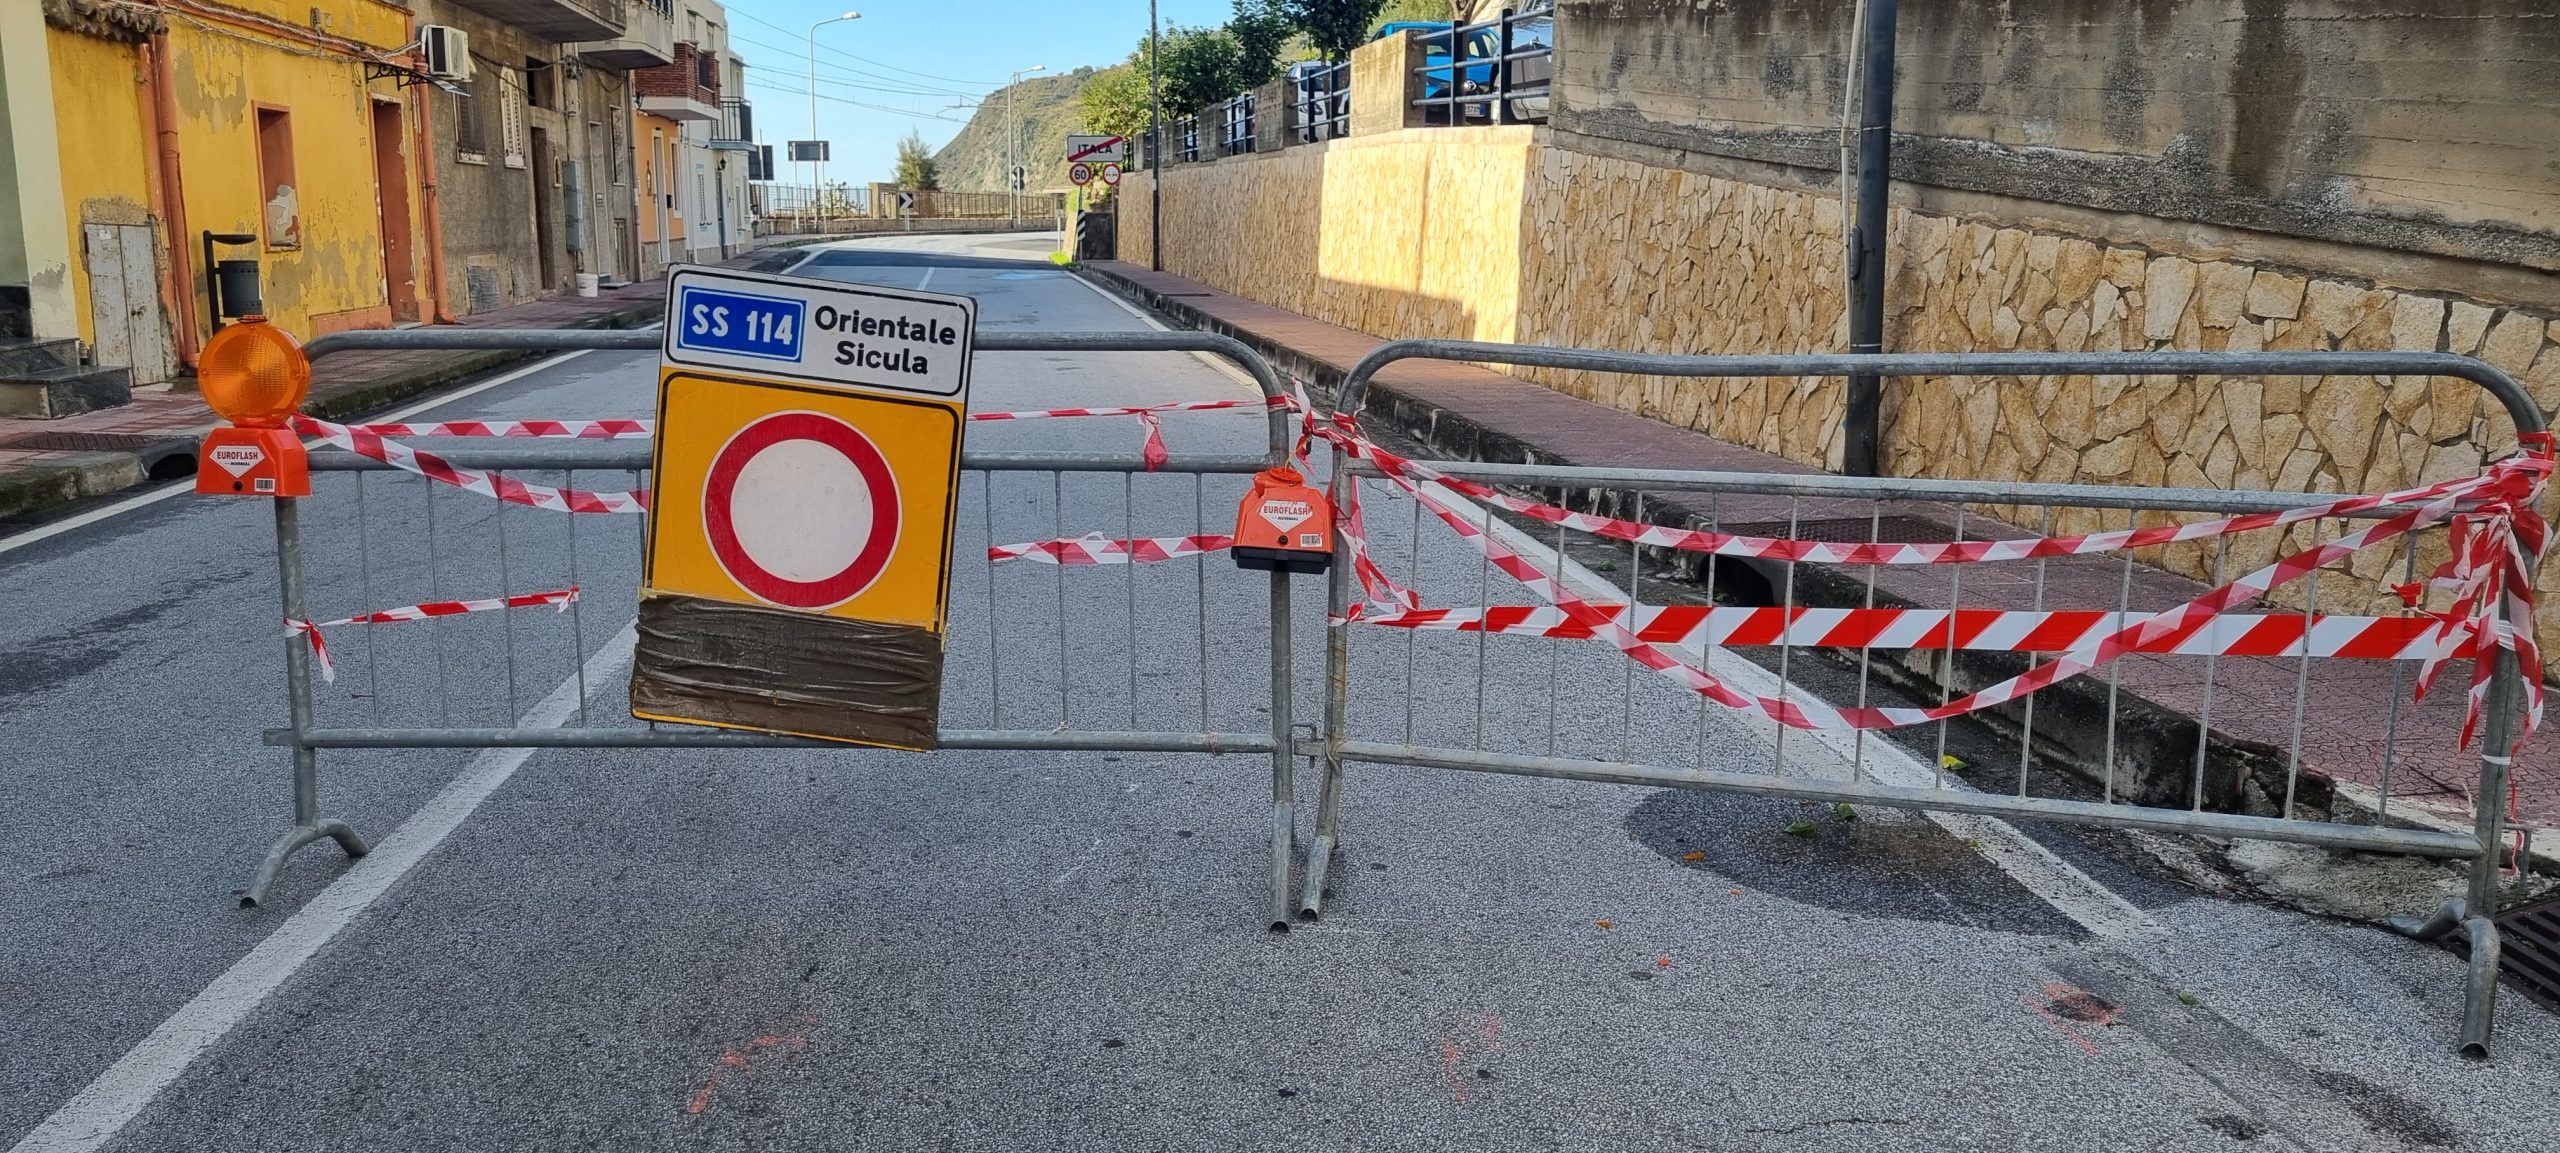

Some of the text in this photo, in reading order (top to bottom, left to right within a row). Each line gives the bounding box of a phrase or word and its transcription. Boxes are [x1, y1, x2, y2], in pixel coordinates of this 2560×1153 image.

[1074, 169, 1087, 180] 60
[691, 303, 793, 346] SS 114
[814, 305, 956, 346] Orientale
[834, 340, 929, 375] Sicula
[216, 451, 258, 460] EUROFLASH
[1263, 505, 1308, 515] EUROFLASH
